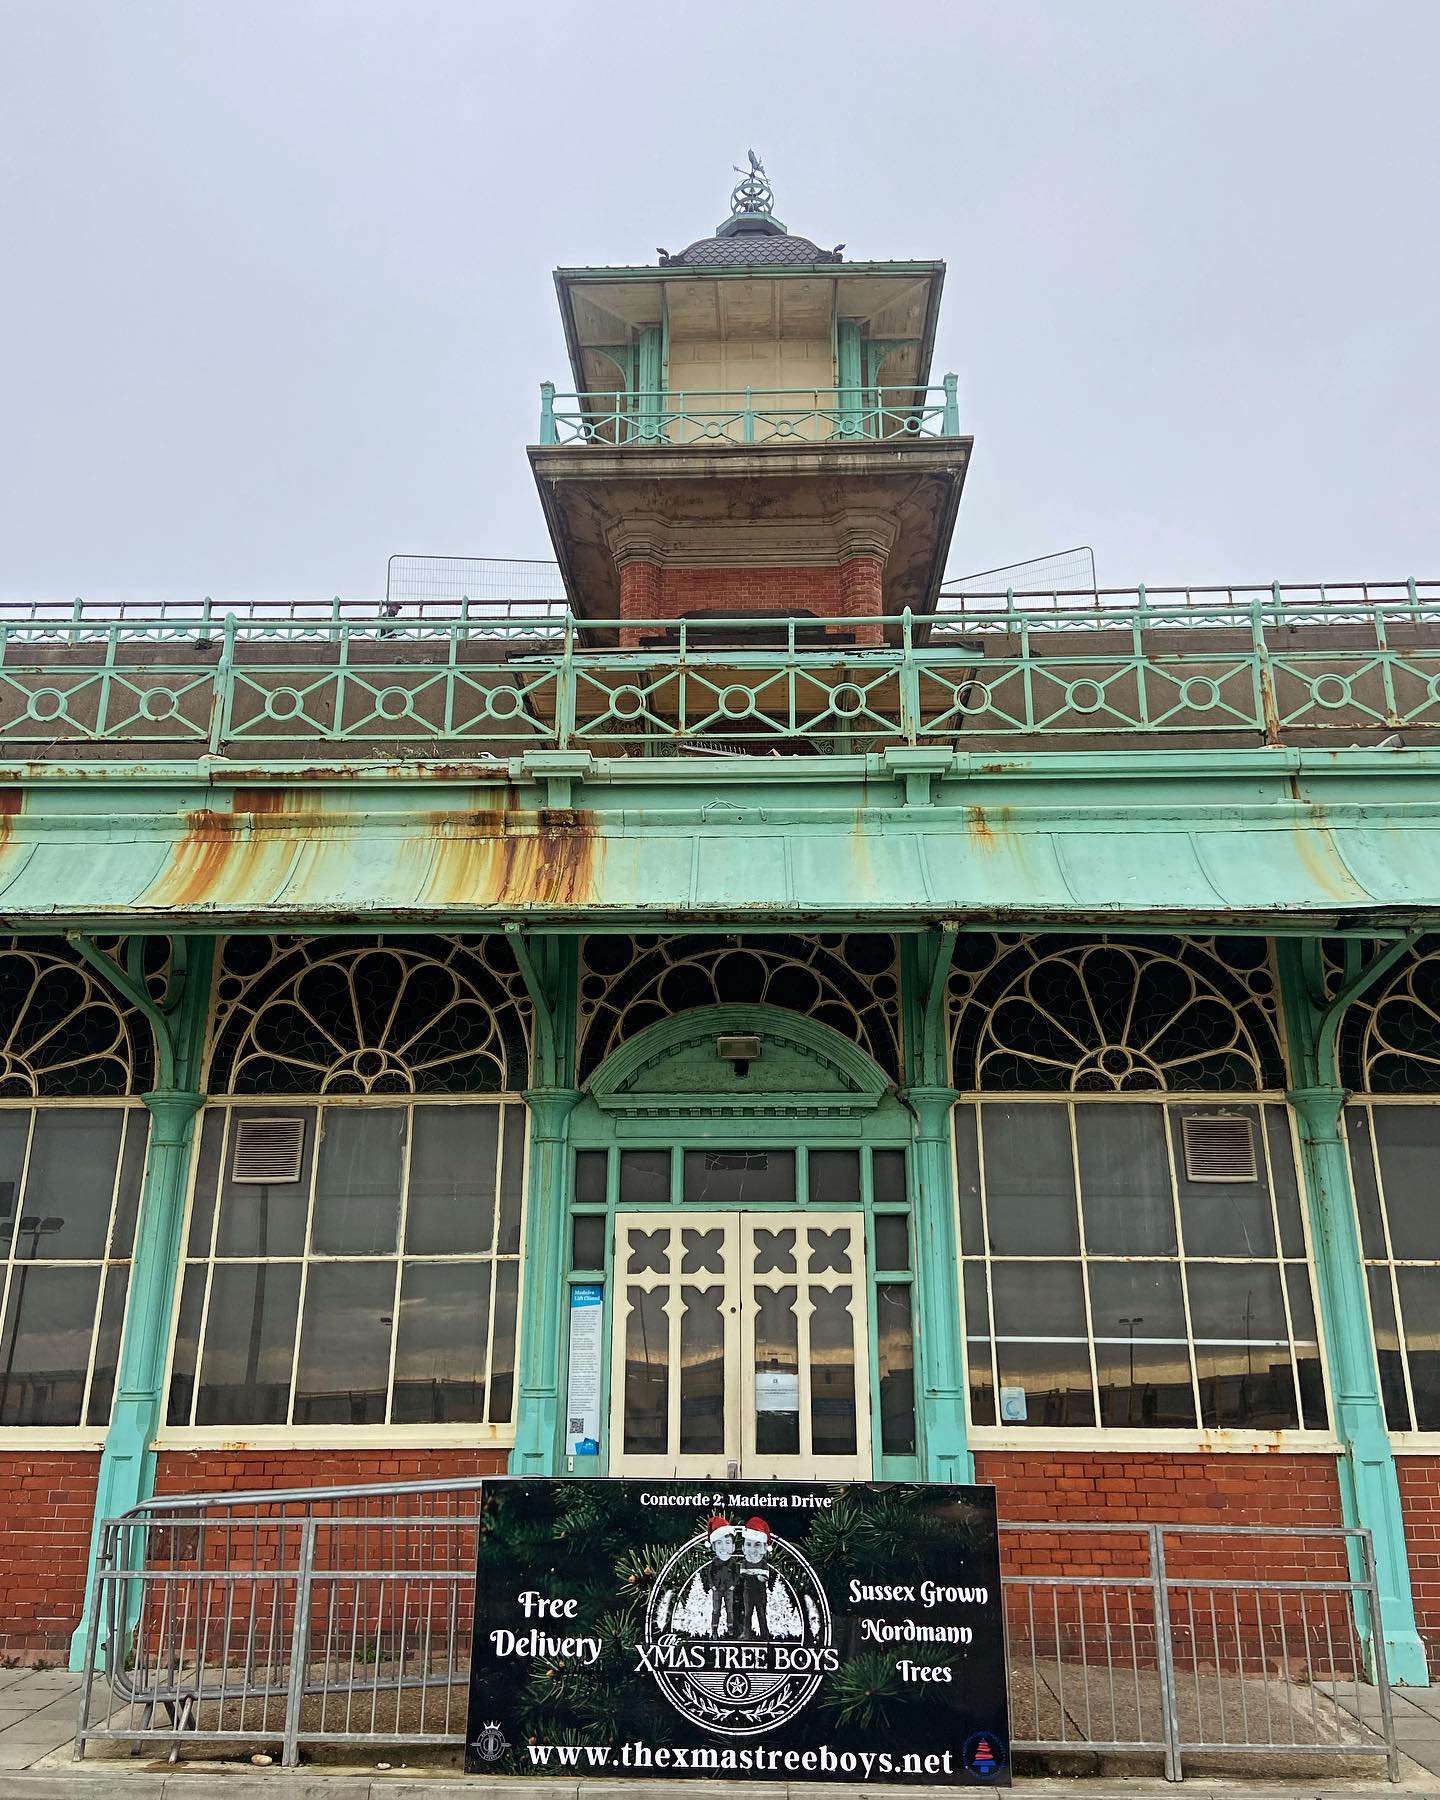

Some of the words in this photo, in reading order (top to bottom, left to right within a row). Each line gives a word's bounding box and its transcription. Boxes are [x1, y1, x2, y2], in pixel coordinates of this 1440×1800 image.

[640, 1493, 709, 1506] Concorde
[728, 1494, 788, 1508] Madeira
[791, 1494, 832, 1508] Drive
[517, 1591, 578, 1618] Free
[848, 1578, 916, 1604] Sussex
[920, 1581, 989, 1609] Grown
[657, 1632, 682, 1648] The
[861, 1619, 973, 1645] Nordmann
[490, 1629, 603, 1665] Delivery
[634, 1644, 706, 1672] XMAS
[709, 1647, 768, 1670] TREE
[774, 1648, 840, 1672] BOYS
[896, 1659, 952, 1683] Trees
[527, 1742, 954, 1779] www.thexmastreeboys.net
